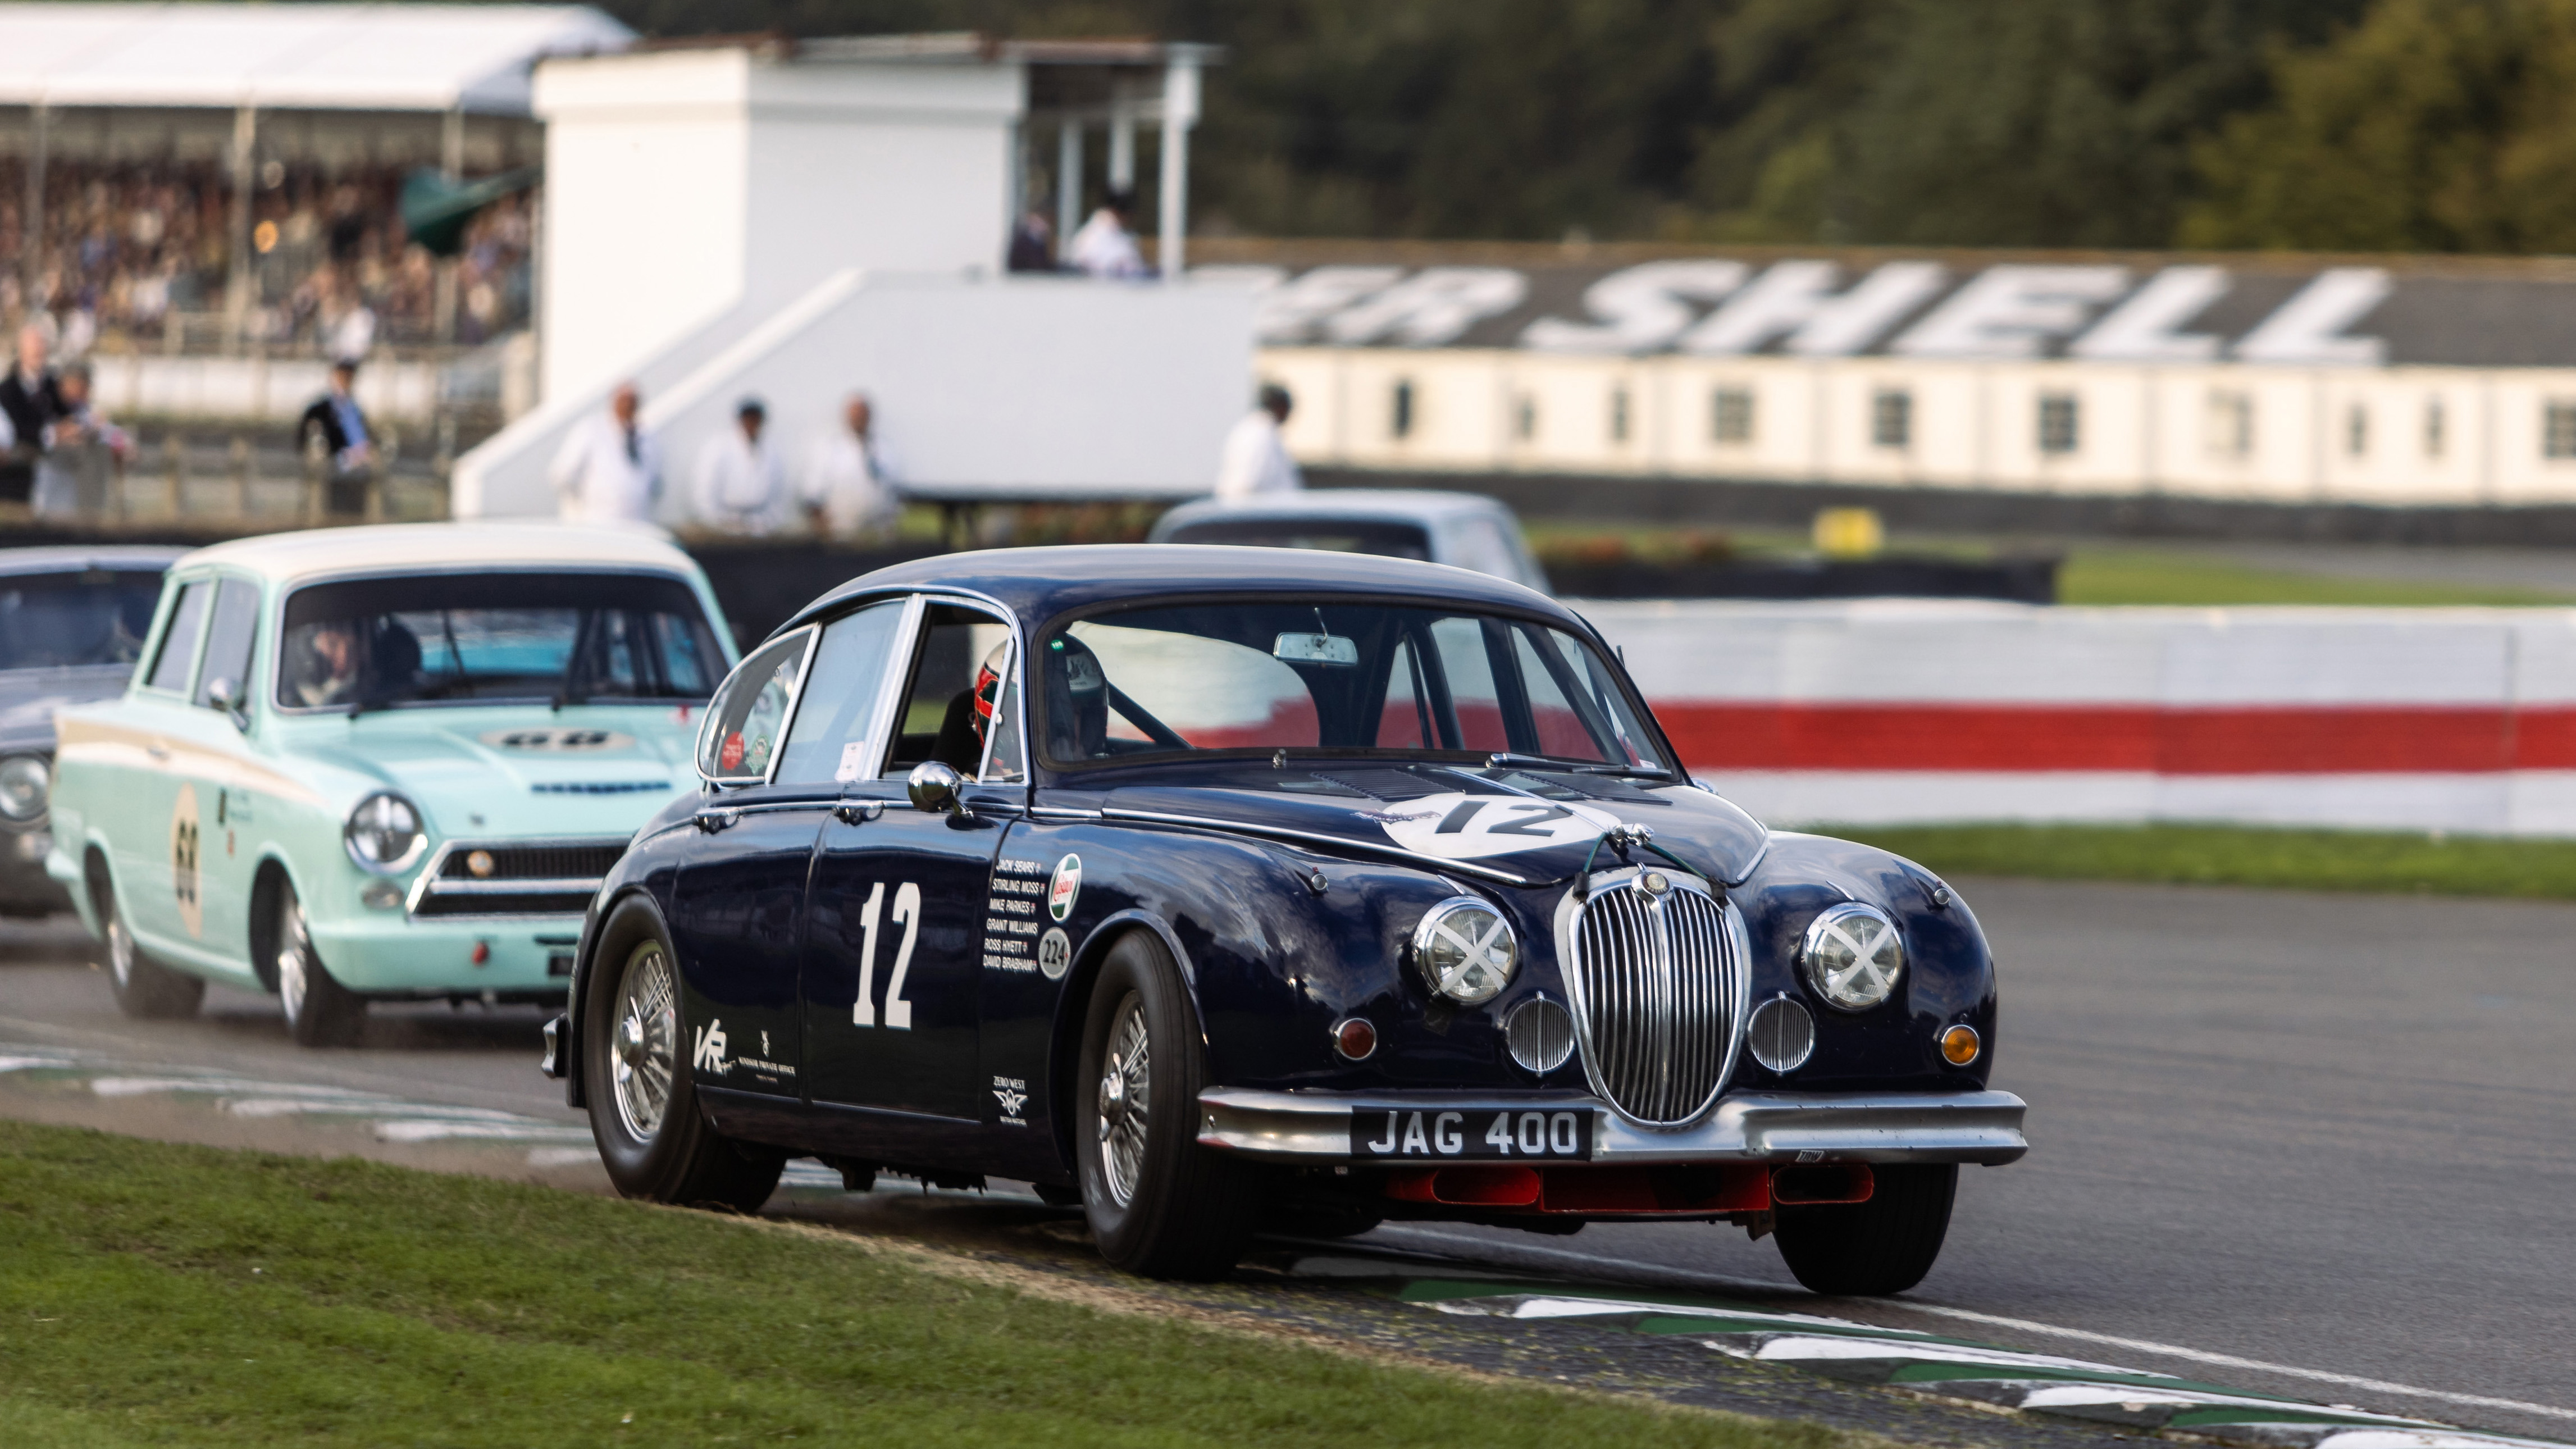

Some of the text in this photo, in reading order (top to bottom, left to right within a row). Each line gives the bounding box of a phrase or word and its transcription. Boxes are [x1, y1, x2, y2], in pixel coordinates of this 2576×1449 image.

[1521, 259, 2393, 361] SHELL
[1435, 800, 1574, 837] 12
[1014, 860, 1036, 875] SEARS
[992, 878, 1039, 895] STIRLING MOSS
[989, 898, 1031, 914] MIKE PARKES
[987, 918, 1038, 935] GRANT WILLIAMS
[984, 938, 1001, 951] ROSS
[1043, 938, 1065, 967] 224
[853, 882, 920, 1030] 12
[983, 954, 1033, 972] DAVID BRABHAM
[993, 1076, 1025, 1091] ZERO WEST
[1367, 1110, 1577, 1155] JAG 400
